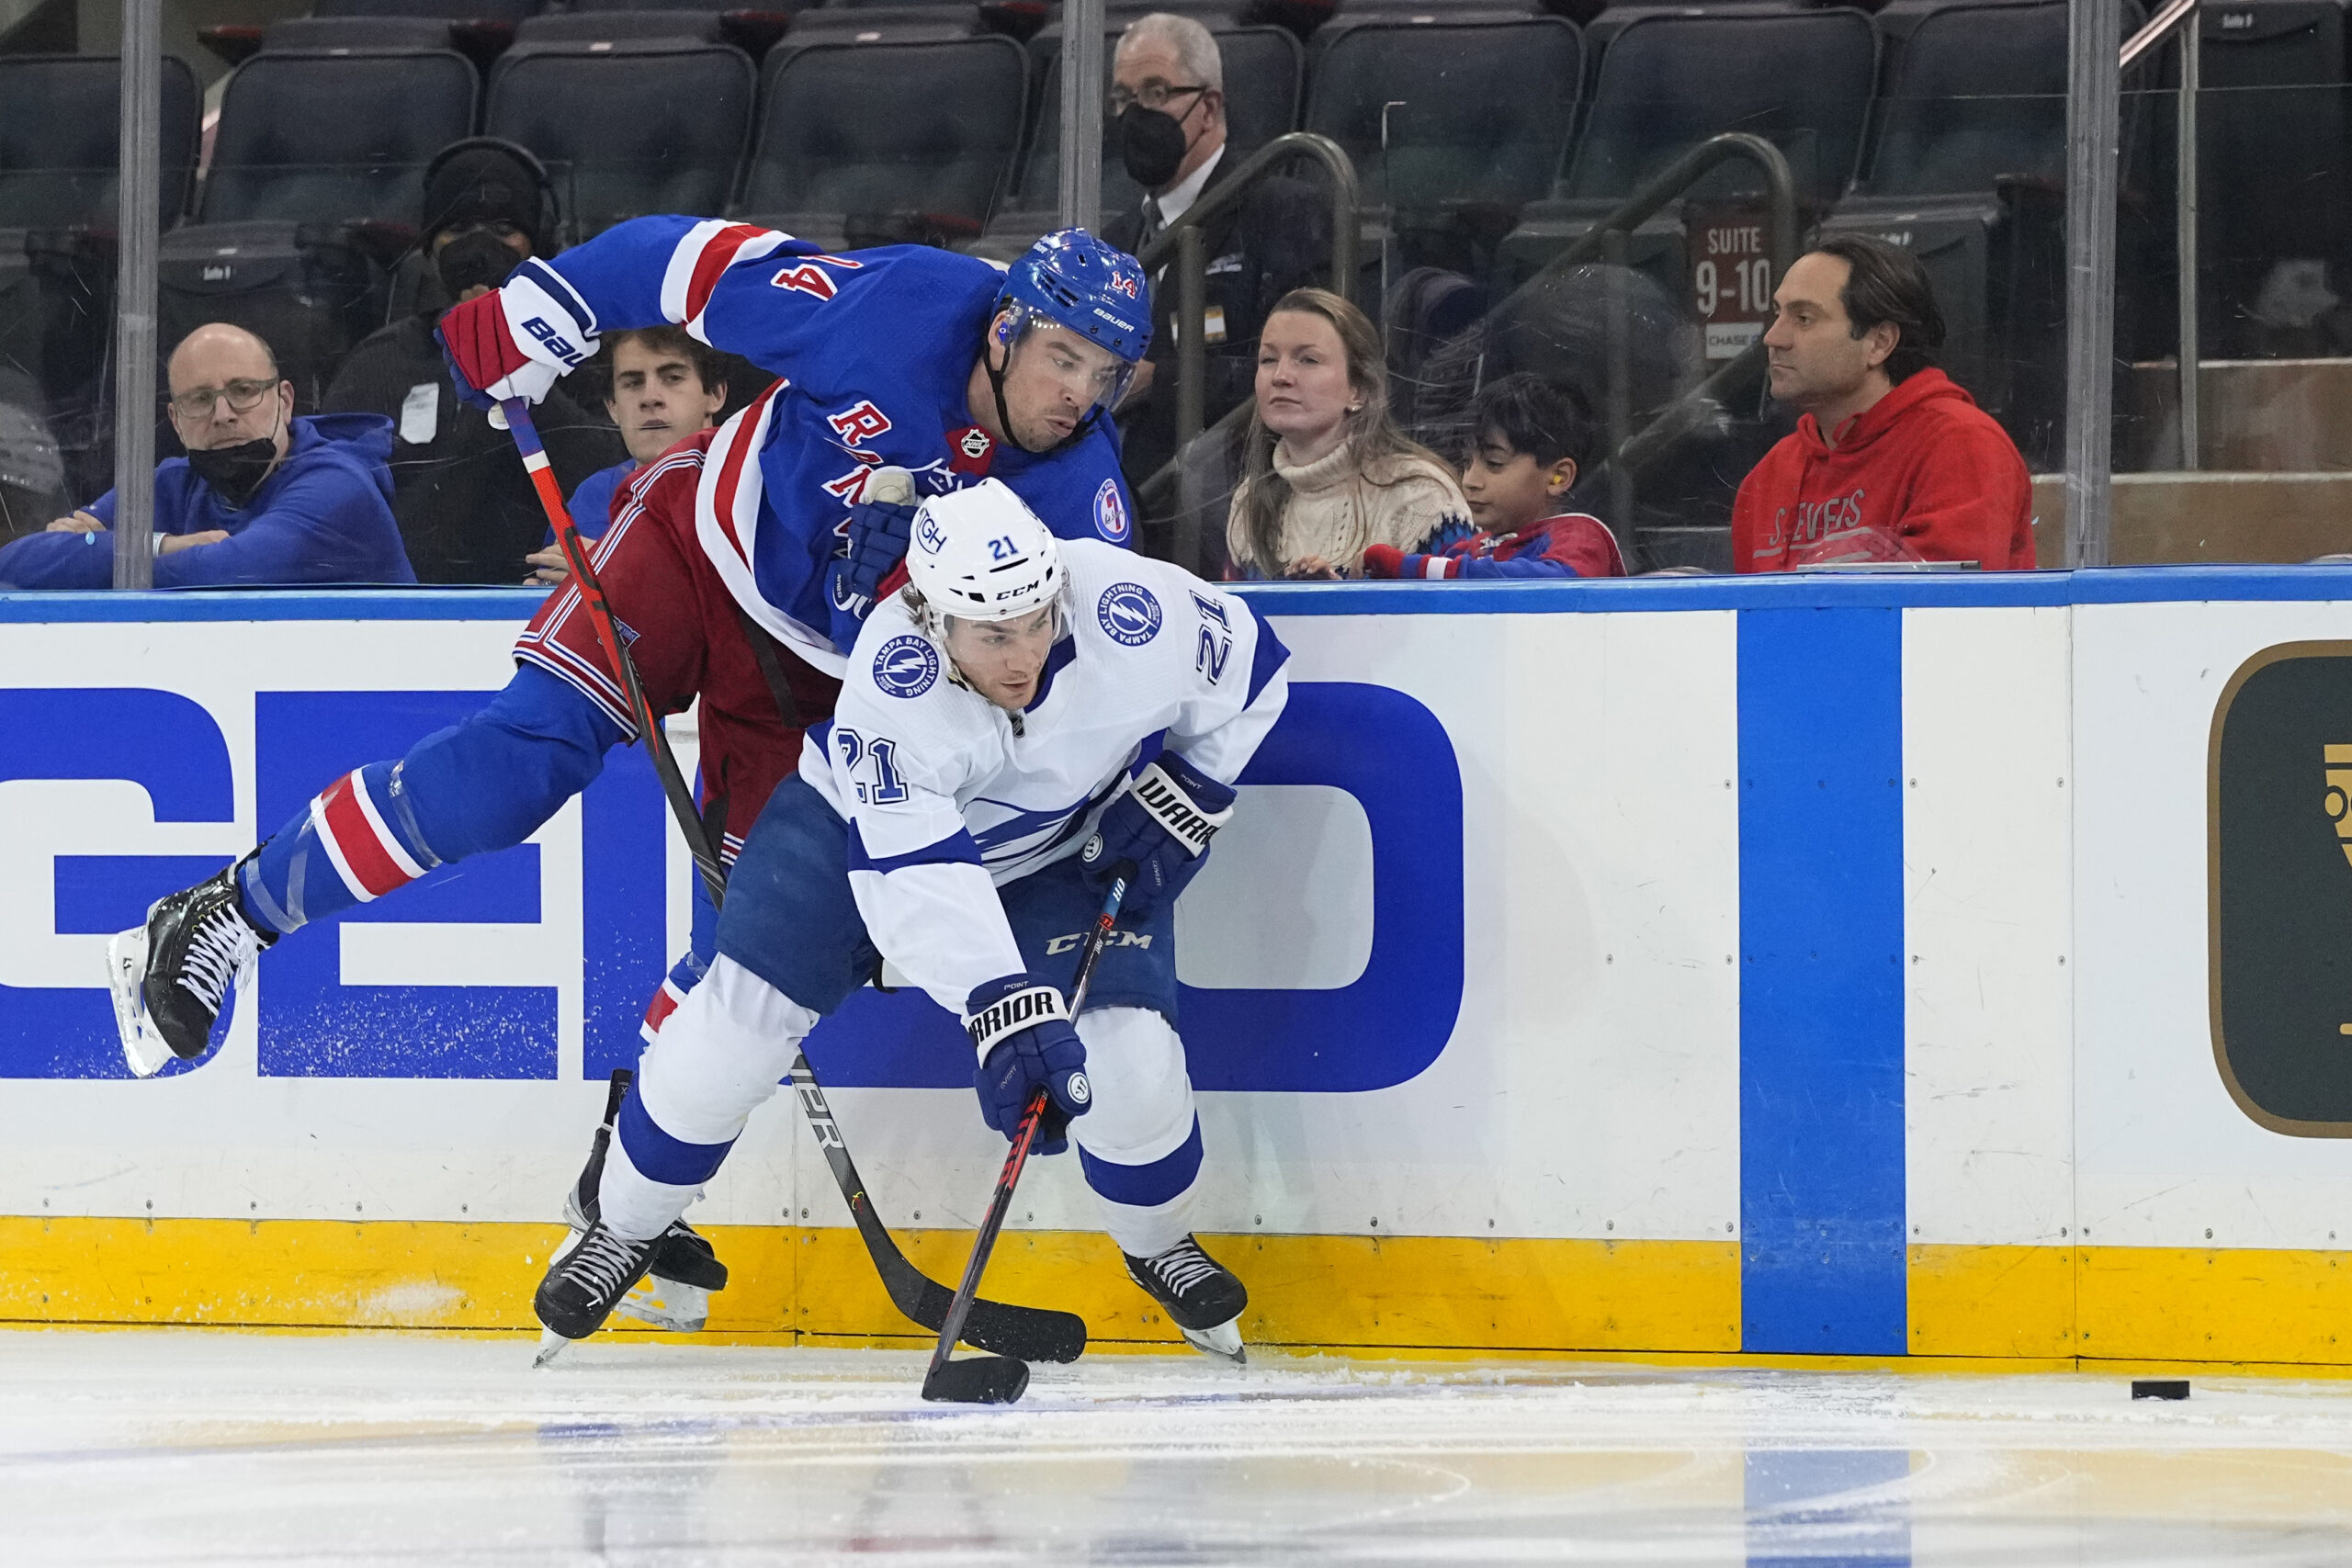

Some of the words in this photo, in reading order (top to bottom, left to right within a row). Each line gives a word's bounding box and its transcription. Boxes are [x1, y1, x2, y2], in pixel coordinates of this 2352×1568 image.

[1708, 227, 1762, 254] SUITE
[1112, 271, 1136, 299] 14
[1696, 258, 1770, 315] 9-10
[1093, 308, 1136, 333] BAUER
[1708, 334, 1747, 346] CHASE
[1105, 491, 1122, 530] 7
[1769, 488, 1865, 547] SEVES
[988, 536, 1020, 561] 21
[996, 580, 1040, 601] CCM
[1099, 584, 1144, 615] LIGHTNING
[1101, 618, 1118, 637] BAY
[1119, 630, 1153, 645] TAMPA
[1189, 589, 1233, 687] 21
[875, 638, 903, 666] TAMPA
[906, 637, 927, 649] BAY
[905, 649, 937, 697] LIGHTNING
[836, 728, 910, 805] 21
[1180, 773, 1204, 790] POINT
[0, 682, 1464, 1093] GEIO
[1003, 980, 1029, 991] POINT
[968, 991, 1055, 1048] RRIOR
